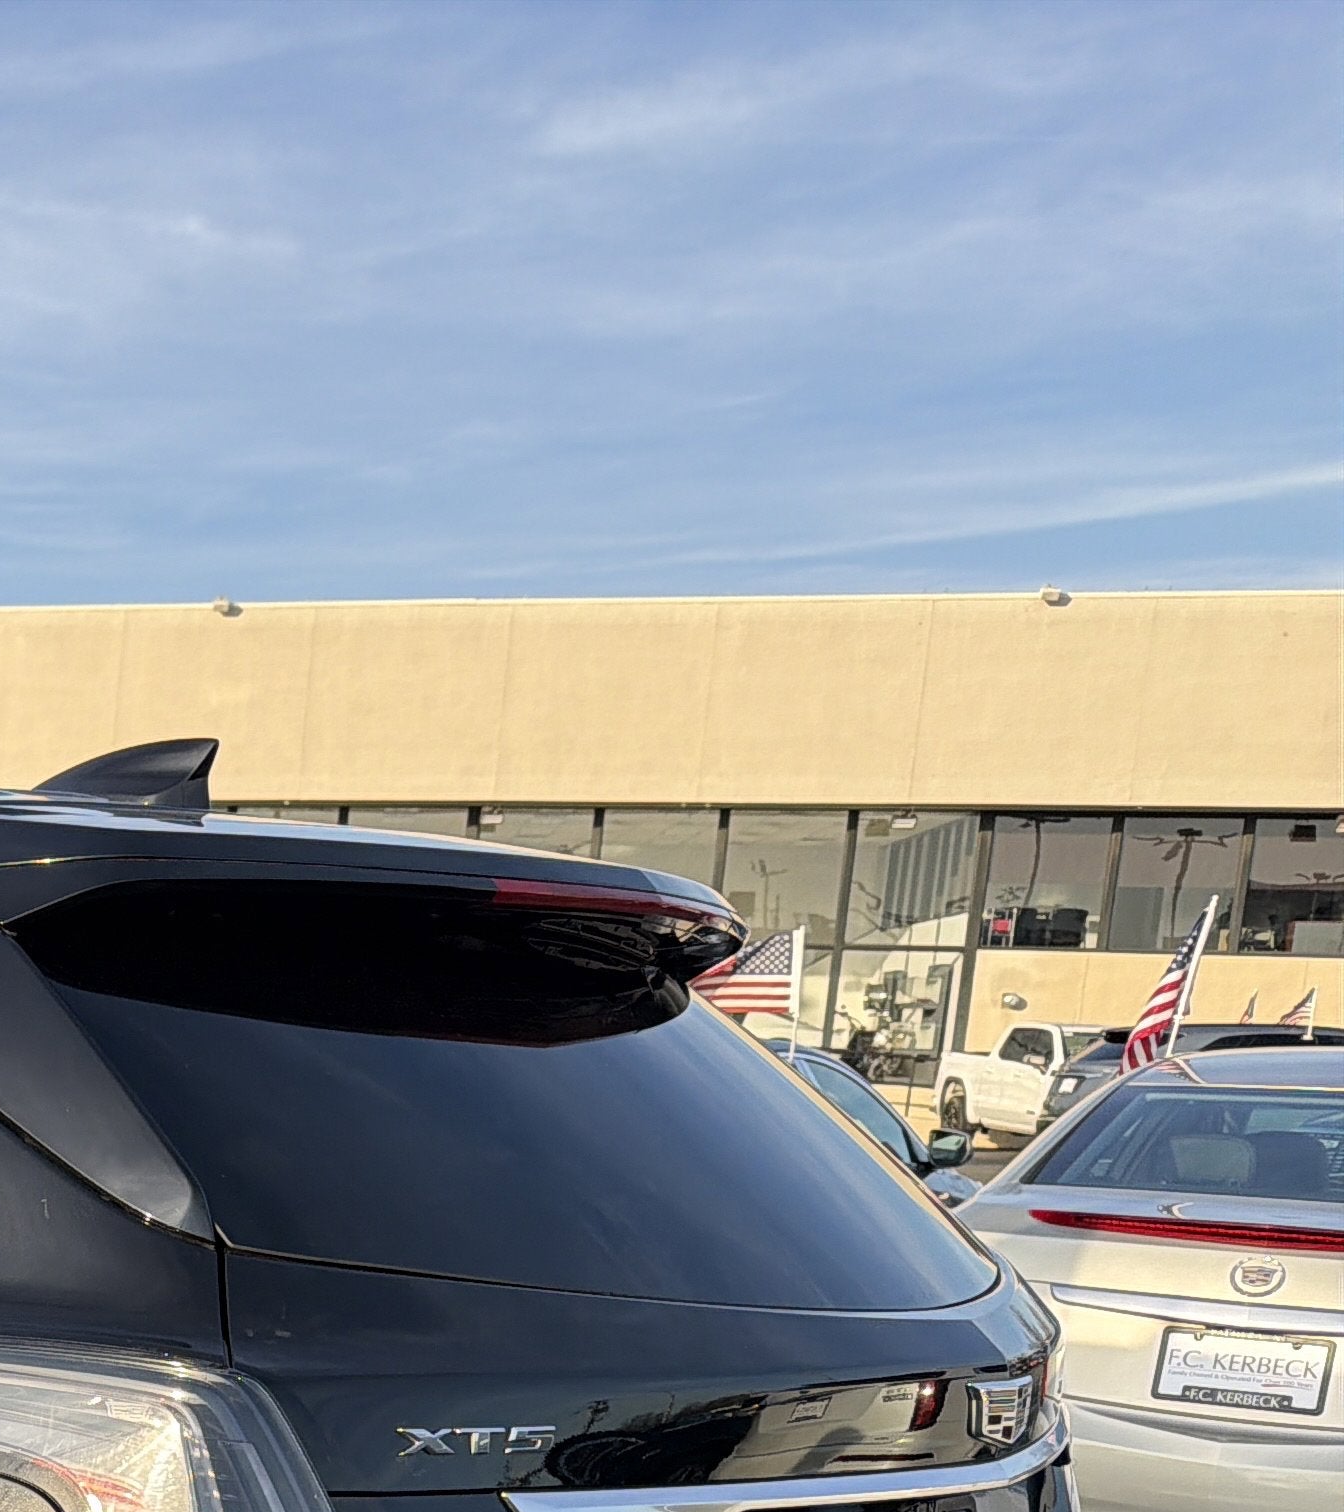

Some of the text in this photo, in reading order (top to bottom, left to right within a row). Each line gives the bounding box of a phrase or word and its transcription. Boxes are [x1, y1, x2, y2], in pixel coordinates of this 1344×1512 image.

[1168, 1348, 1320, 1380] F.C. KERBECK
[1216, 1390, 1282, 1409] KERBECK
[396, 1424, 557, 1456] XT5
